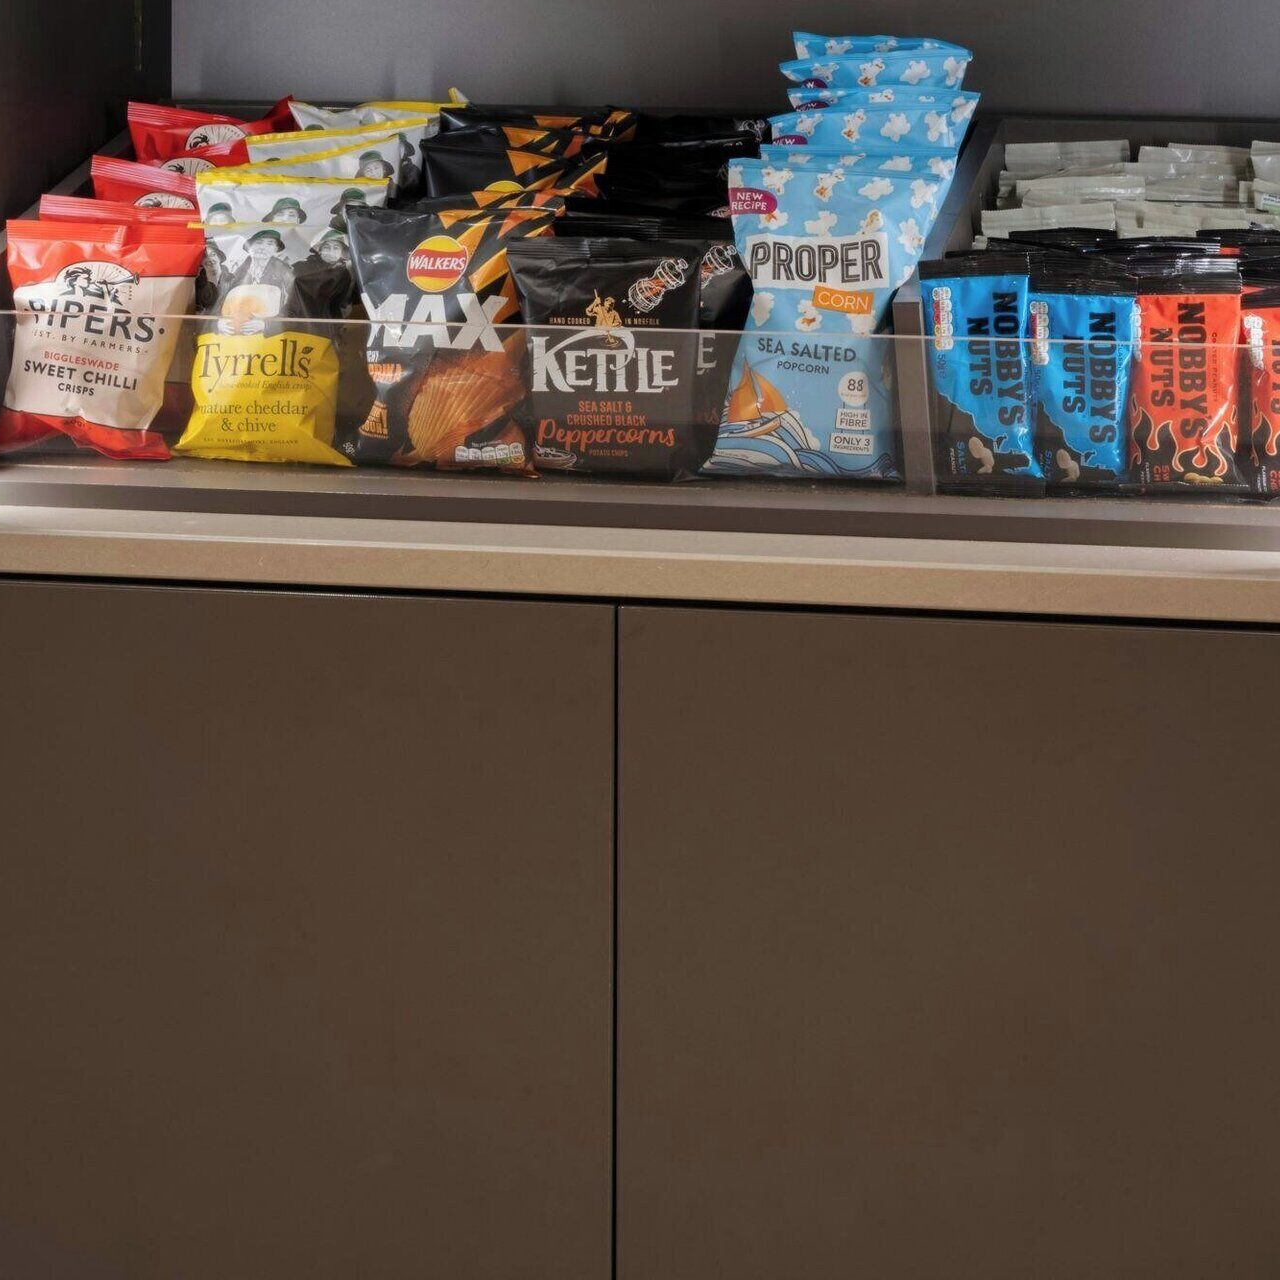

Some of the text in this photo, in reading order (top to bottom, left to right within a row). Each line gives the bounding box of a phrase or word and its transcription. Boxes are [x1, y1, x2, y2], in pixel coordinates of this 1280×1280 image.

[737, 192, 763, 200] NEW
[410, 255, 465, 271] WALKERS
[749, 240, 883, 284] PROPER
[817, 291, 869, 310] CORN
[362, 293, 509, 352] MAX
[83, 338, 141, 354] FARMERS
[758, 337, 856, 363] SEA SALTED
[44, 351, 120, 371] BIGGLESWADE
[531, 330, 678, 393] KETTLE
[967, 317, 993, 396] NUTS
[24, 361, 137, 390] SWEET CHILLI
[777, 361, 829, 374] POPCORN
[1063, 335, 1085, 413] NUTS
[1150, 327, 1175, 408] NUTS
[1178, 301, 1212, 439] NOBBY'S
[58, 383, 95, 395] CRISPS
[246, 401, 308, 415] cheddar
[578, 400, 623, 413] SEA SALT
[221, 418, 276, 432] & chive
[567, 414, 647, 426] CRUSHED BLACK
[840, 418, 867, 427] FIBRE
[538, 419, 675, 452] Peppercorns
[834, 436, 870, 447] ONLY 3
[833, 444, 870, 452] INGREDIENTS
